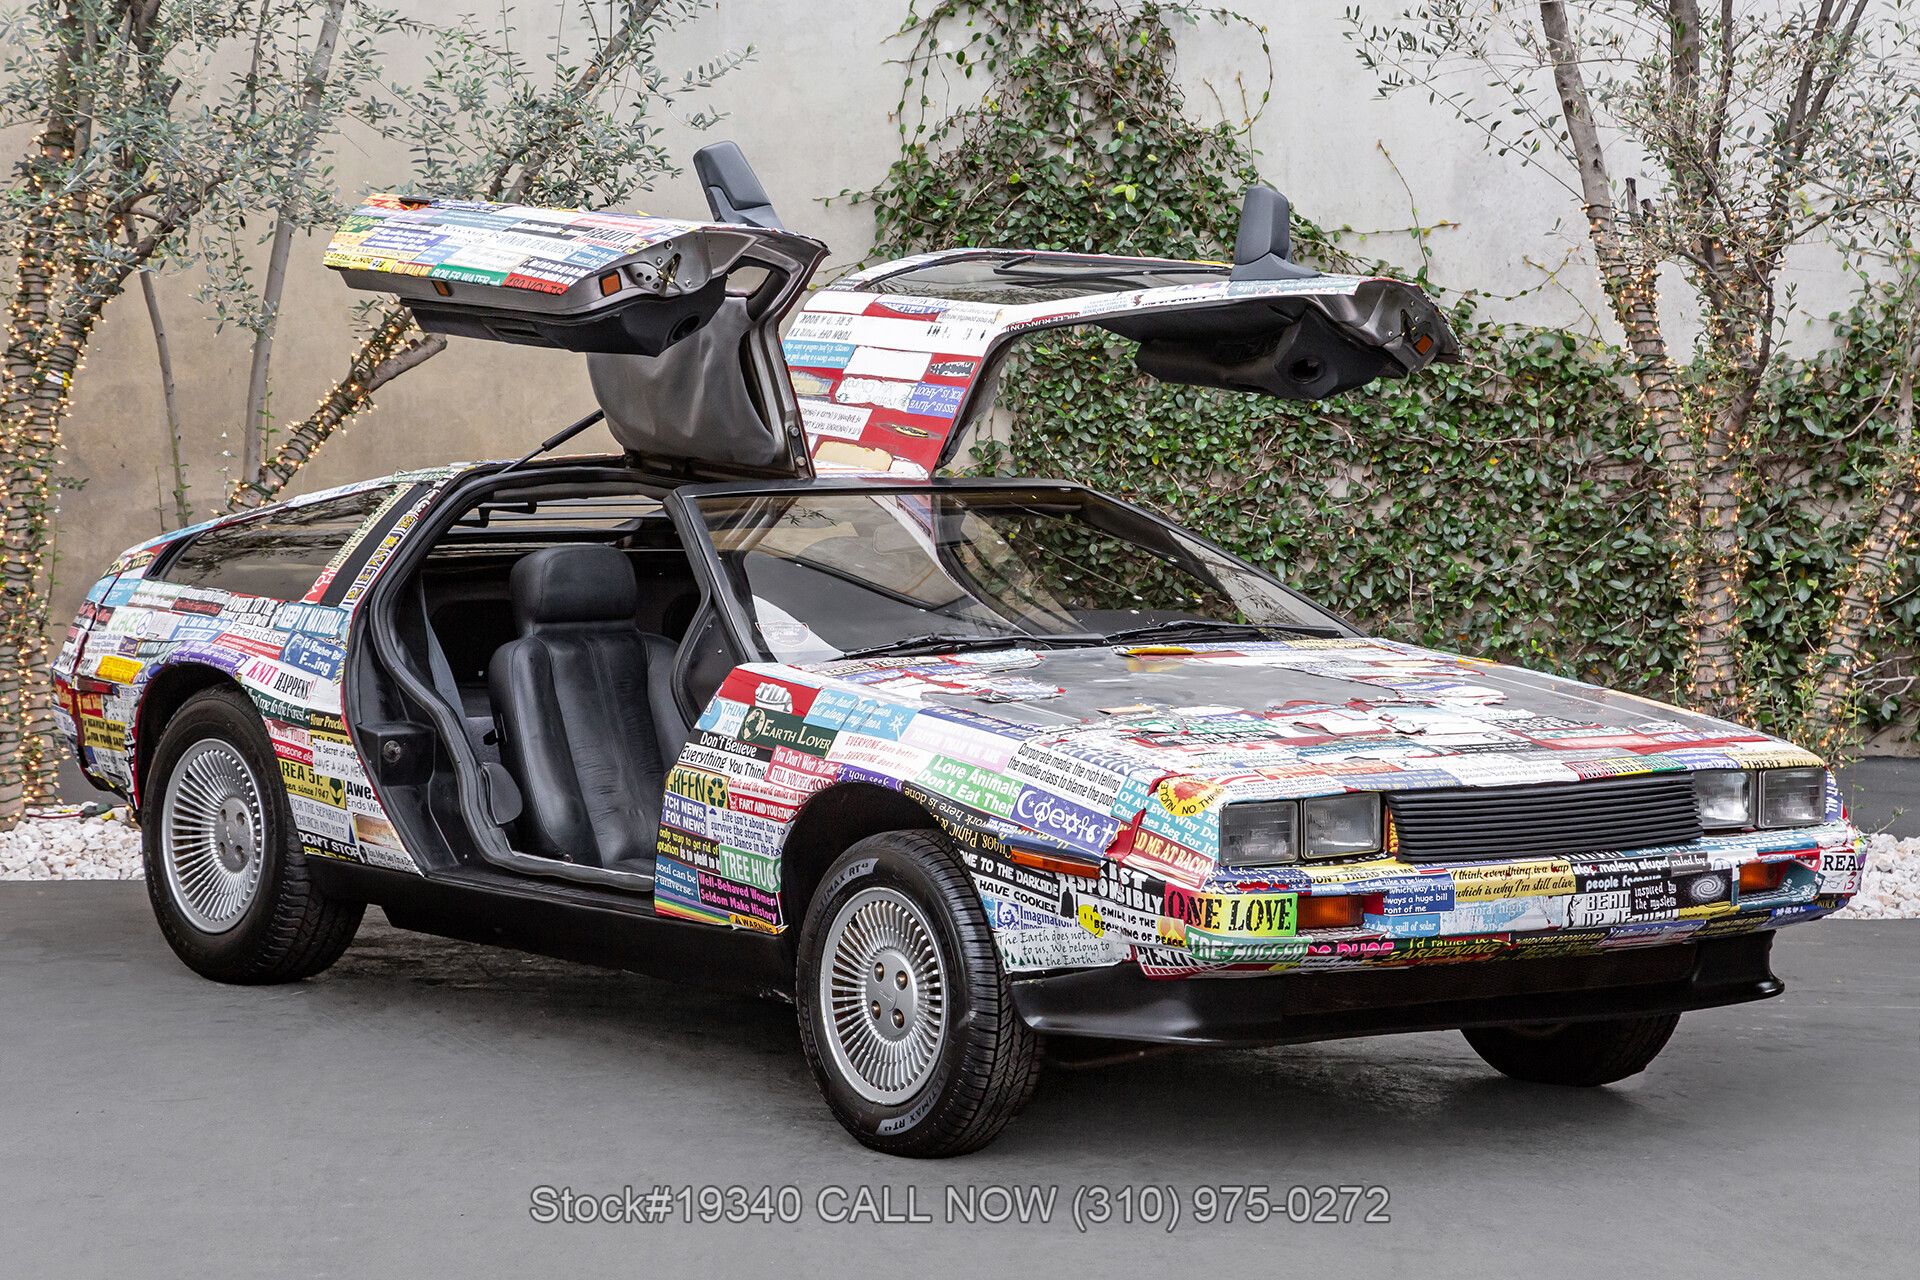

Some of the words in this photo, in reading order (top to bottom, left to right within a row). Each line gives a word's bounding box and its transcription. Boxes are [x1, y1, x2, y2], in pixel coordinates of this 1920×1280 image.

[229, 624, 287, 646] Prejudice
[248, 661, 278, 686] KNIT
[722, 720, 741, 735] ACT
[700, 733, 725, 749] Don't
[726, 737, 757, 758] Believe
[680, 745, 728, 769] Everything
[729, 758, 743, 775] You
[744, 762, 767, 780] Think
[1017, 743, 1052, 767] Corporate
[1052, 753, 1074, 772] media:
[1073, 763, 1084, 776] the
[1083, 766, 1099, 783] rich
[1098, 774, 1122, 794] telling
[919, 770, 955, 794] Don't
[957, 782, 981, 804] Eat
[934, 756, 967, 780] Love
[967, 768, 1022, 798] Animals
[1007, 756, 1018, 769] the
[1018, 760, 1040, 780] middle
[1040, 769, 1058, 786] class
[1059, 777, 1068, 789] to
[1067, 779, 1088, 798] blame
[1087, 785, 1099, 801] the
[315, 787, 329, 800] 1947
[738, 797, 754, 813] FART
[938, 802, 965, 822] here
[1181, 805, 1197, 816] NO
[665, 810, 681, 825] FOX
[682, 817, 706, 836] NEWS
[722, 810, 734, 827] Life
[734, 813, 749, 828] isn't
[749, 817, 765, 832] about
[1149, 801, 1172, 825] Evil,
[1175, 815, 1199, 834] Why
[1200, 826, 1218, 842] Do
[299, 833, 328, 849] DON'T
[711, 822, 733, 836] survive
[733, 824, 743, 838] the
[763, 833, 774, 846] but
[1160, 822, 1182, 842] Beg
[1183, 831, 1201, 847] For
[725, 835, 733, 846] to
[734, 836, 753, 852] Dance
[753, 842, 760, 853] in
[760, 843, 770, 855] the
[721, 850, 751, 882] TREE
[1148, 837, 1164, 858] ME
[1160, 843, 1179, 863] AT
[1175, 847, 1215, 878] BACON
[1599, 860, 1638, 873] making
[1638, 857, 1670, 870] stupid
[1671, 854, 1693, 867] ruled
[1694, 854, 1706, 866] by
[672, 868, 685, 880] can
[686, 871, 697, 884] be
[980, 857, 994, 872] TO
[996, 863, 1015, 880] THE
[1015, 869, 1060, 897] DARKSIDE
[1310, 873, 1341, 884] DON'T
[1343, 870, 1380, 882] TREAD
[1384, 867, 1397, 877] ON
[1399, 866, 1416, 875] ME
[1458, 868, 1483, 880] think
[1487, 866, 1532, 881] everything
[699, 872, 750, 898] Well-Behaved
[750, 885, 777, 907] Women
[1389, 884, 1411, 895] which
[1411, 885, 1428, 895] way
[1437, 884, 1454, 892] turn
[1456, 886, 1483, 899] which
[1484, 886, 1492, 896] is
[1493, 881, 1515, 898] why
[1515, 879, 1530, 893] I'm
[1531, 878, 1550, 891] still
[1552, 876, 1576, 890] alive.
[1586, 876, 1619, 892] people
[1634, 883, 1664, 898] inspired
[1667, 881, 1677, 895] by
[814, 872, 846, 919] LTIMAX
[979, 880, 1011, 897] HAVE
[1013, 890, 1059, 916] COOKIES.
[1415, 894, 1434, 906] huge
[1436, 892, 1448, 902] bill
[1635, 898, 1647, 911] the
[700, 889, 729, 909] Seldom
[729, 897, 750, 912] Make
[750, 904, 778, 925] History
[1093, 904, 1099, 914] A
[1128, 915, 1138, 926] IS
[1139, 917, 1157, 929] THE
[1168, 891, 1222, 931] ONE
[1228, 897, 1293, 935] LOVE
[1403, 904, 1413, 913] of
[1414, 905, 1427, 913] me
[1394, 920, 1409, 933] spill
[1419, 918, 1437, 930] solar
[997, 933, 1018, 946] The
[1020, 930, 1048, 943] Earth
[1051, 929, 1069, 941] does
[1071, 930, 1087, 941] not
[1140, 932, 1153, 944] OF
[1410, 938, 1425, 949] I'd
[1022, 945, 1032, 956] to
[1051, 943, 1067, 955] We
[1068, 940, 1098, 956] belong
[1100, 940, 1110, 951] to
[1388, 943, 1501, 961] GARDENING
[1045, 956, 1061, 967] the
